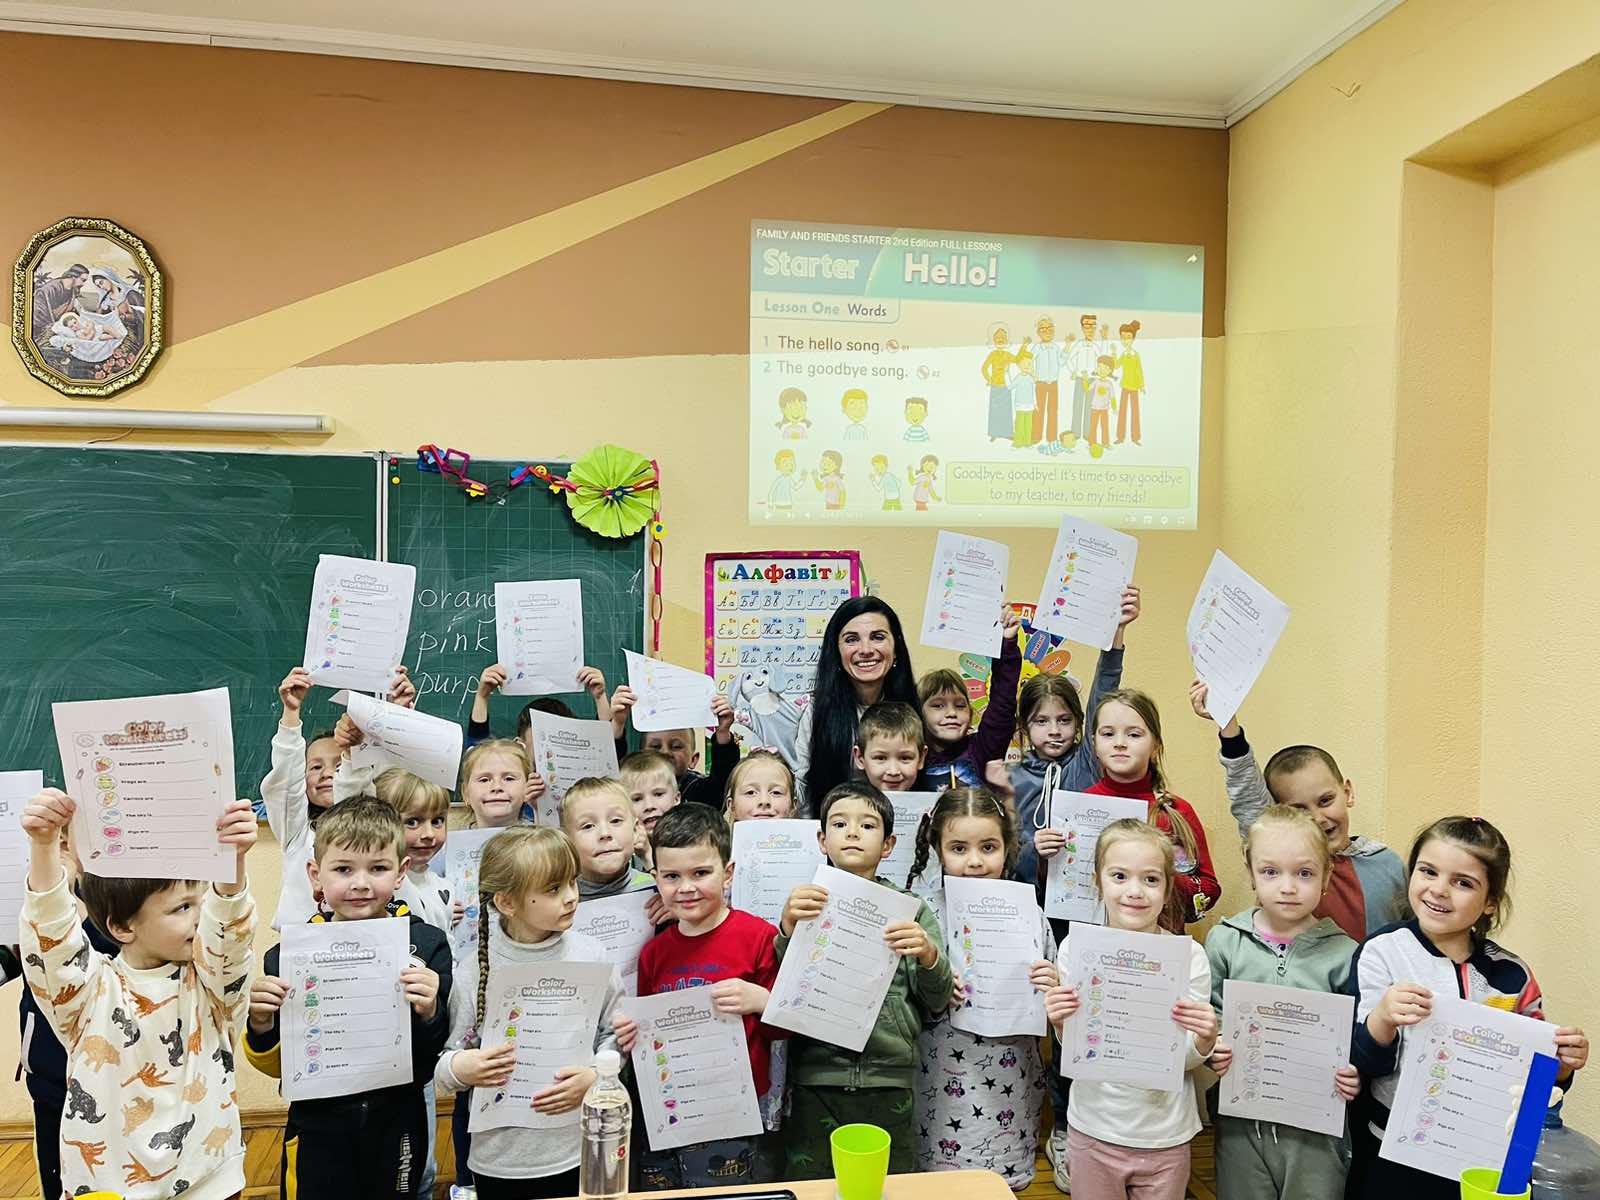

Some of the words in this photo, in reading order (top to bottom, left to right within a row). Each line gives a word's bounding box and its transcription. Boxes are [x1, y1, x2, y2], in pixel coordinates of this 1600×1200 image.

[756, 228, 790, 240] FAMILY
[790, 231, 810, 241] AND
[812, 232, 850, 243] FRIENDS
[852, 234, 891, 246] STARTER
[893, 236, 909, 247] 2nd
[910, 238, 939, 248] Edition
[940, 239, 962, 250] FULL
[963, 241, 1003, 252] LESSONS
[763, 248, 860, 280] Starter
[904, 252, 998, 288] Hello!
[764, 299, 807, 314] Lesson
[812, 301, 840, 315] One
[848, 303, 887, 317] Words
[763, 336, 769, 347] 1
[778, 335, 804, 350] The
[809, 337, 842, 351] hello
[763, 361, 771, 373] 2
[777, 360, 803, 374] The
[807, 363, 868, 378] goodbye
[871, 366, 909, 380] song.
[1007, 467, 1057, 486] goodbye!
[1079, 470, 1103, 483] time
[1105, 470, 1116, 483] to
[1120, 474, 1136, 487] say
[1137, 472, 1182, 487] goodbye
[990, 488, 1001, 501] to
[1006, 490, 1023, 504] my
[1072, 489, 1083, 502] to
[1087, 491, 1104, 505] my
[732, 563, 833, 584] Алфавіт
[414, 621, 493, 675] pink
[125, 720, 166, 734] Color
[330, 941, 361, 952] Color
[313, 949, 377, 964] Worksheets
[1117, 949, 1146, 961] Color
[538, 978, 565, 988] Color
[522, 986, 577, 997] Worksheets
[668, 1005, 695, 1017] Color
[1274, 1001, 1304, 1013] Color
[1472, 1025, 1504, 1041] Color
